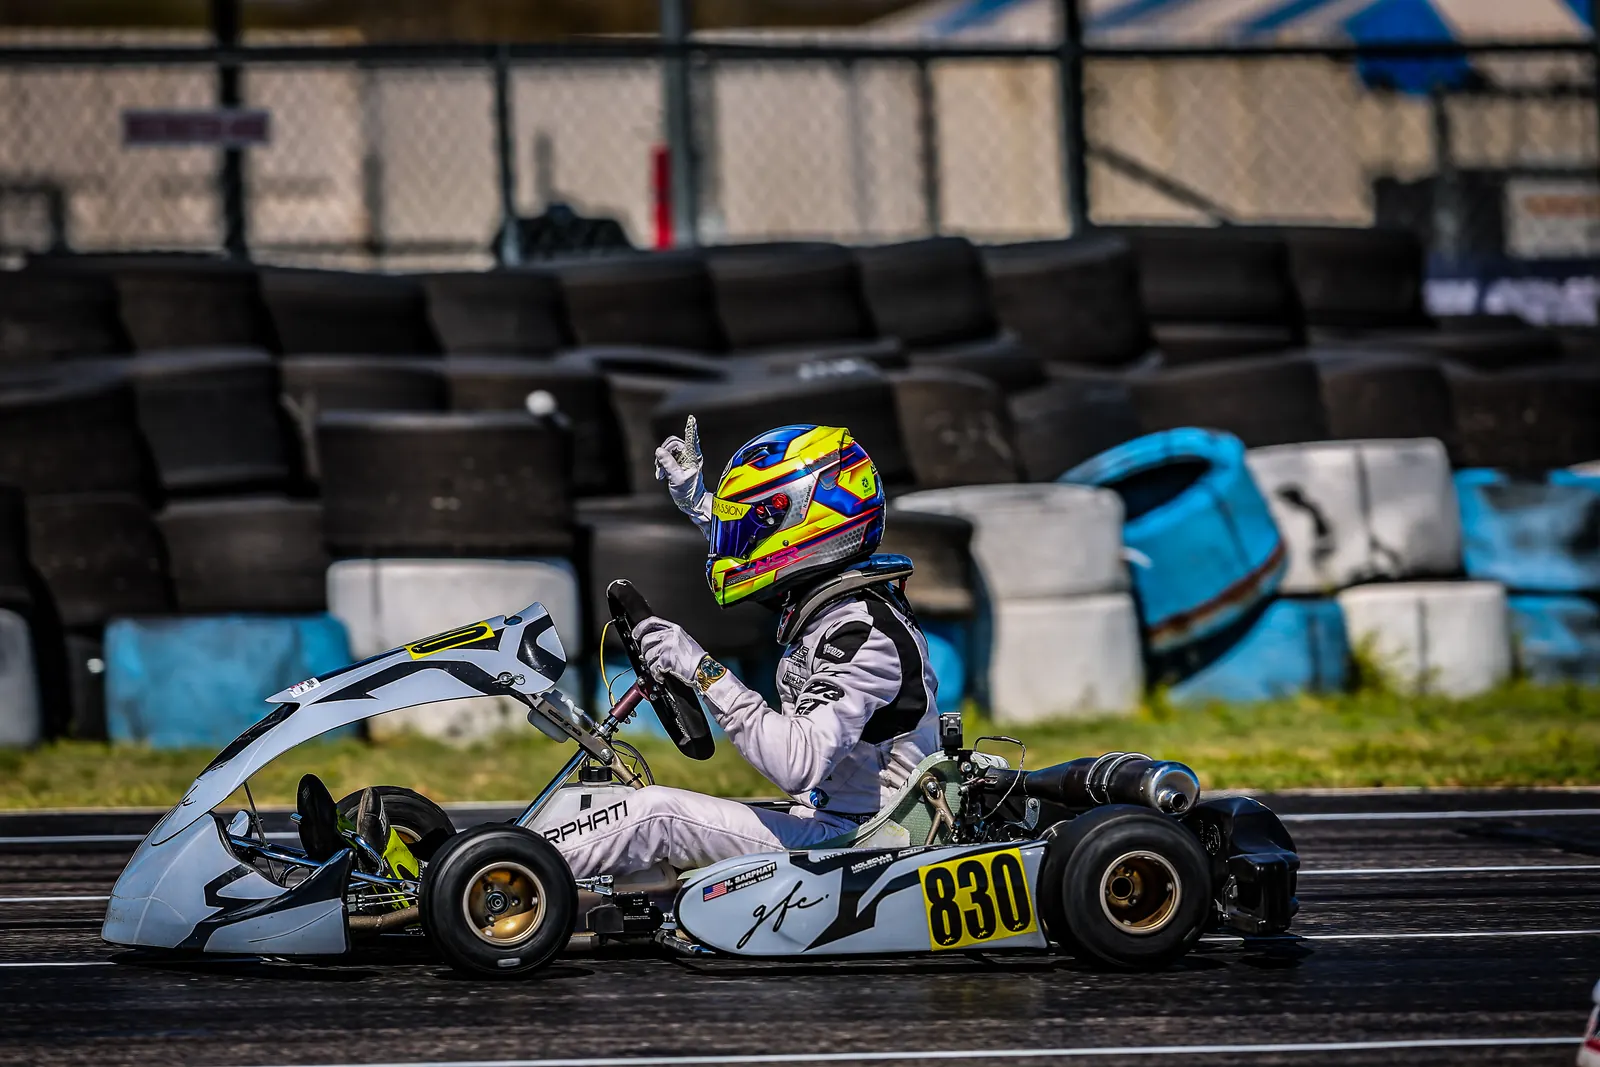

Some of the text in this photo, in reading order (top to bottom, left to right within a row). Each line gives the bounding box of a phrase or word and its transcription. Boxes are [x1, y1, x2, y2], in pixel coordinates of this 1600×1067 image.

[543, 800, 628, 844] RPHATI
[724, 863, 776, 887] N. SARPHATI
[735, 872, 773, 890] OFFICIAL TEAM
[925, 853, 1031, 947] 830
